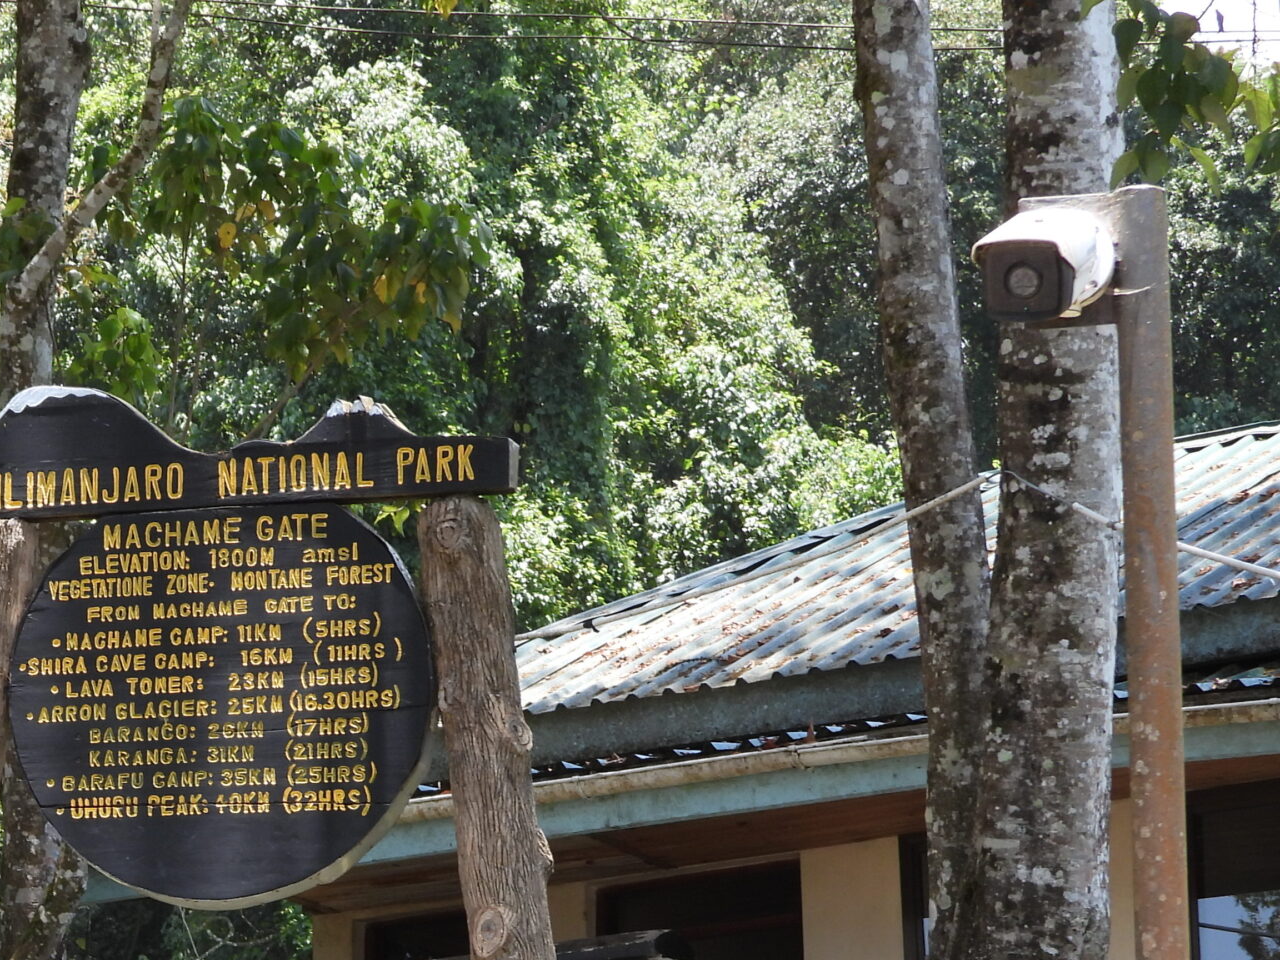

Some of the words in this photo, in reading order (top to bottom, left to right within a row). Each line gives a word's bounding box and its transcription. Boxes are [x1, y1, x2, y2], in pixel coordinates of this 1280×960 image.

[218, 451, 373, 498] NATIONAL
[395, 443, 474, 484] PARK
[102, 517, 240, 549] MACHAME
[255, 512, 328, 540] GATE
[78, 550, 189, 574] ELEVATION:
[208, 546, 274, 568] 1800M
[302, 542, 358, 562] amsl
[48, 575, 152, 600] VEGETATIONE
[230, 566, 312, 590] MONTANE
[326, 562, 394, 585] FOREST
[86, 605, 140, 622] FROM
[151, 598, 247, 618] MACHAME
[264, 596, 313, 613] GATE
[323, 592, 356, 609] TO:
[65, 627, 162, 650] MACHAME
[170, 625, 228, 645] CAMP:
[236, 622, 281, 641] 11KM
[302, 609, 381, 643] (5HRS)
[26, 655, 86, 674] SHIRA
[94, 652, 146, 671] CAVE
[154, 650, 215, 669] CAMP:
[239, 646, 292, 665] 16KM
[66, 678, 113, 697] LAVA
[227, 670, 284, 691] 23KM
[299, 660, 377, 690] (15HRS)
[115, 699, 216, 719] GLACIER:
[227, 694, 282, 714] 25KM
[288, 682, 399, 712] (16.30HRS)
[89, 722, 196, 743] BARANCO:
[207, 720, 264, 739] 26KM
[286, 711, 368, 736] (17HRS)
[89, 746, 197, 766] KARANGA:
[207, 744, 254, 762] 31KM
[285, 737, 367, 761] (21HRS)
[61, 772, 143, 791] BARAFU
[152, 770, 212, 789] CAMP:
[220, 767, 275, 785] 35KM
[286, 760, 377, 785] (25HRS)
[70, 796, 137, 818] UHURU
[147, 793, 208, 815] PEAK:
[215, 791, 269, 813] 40KM
[282, 784, 370, 815] (32HRS)
